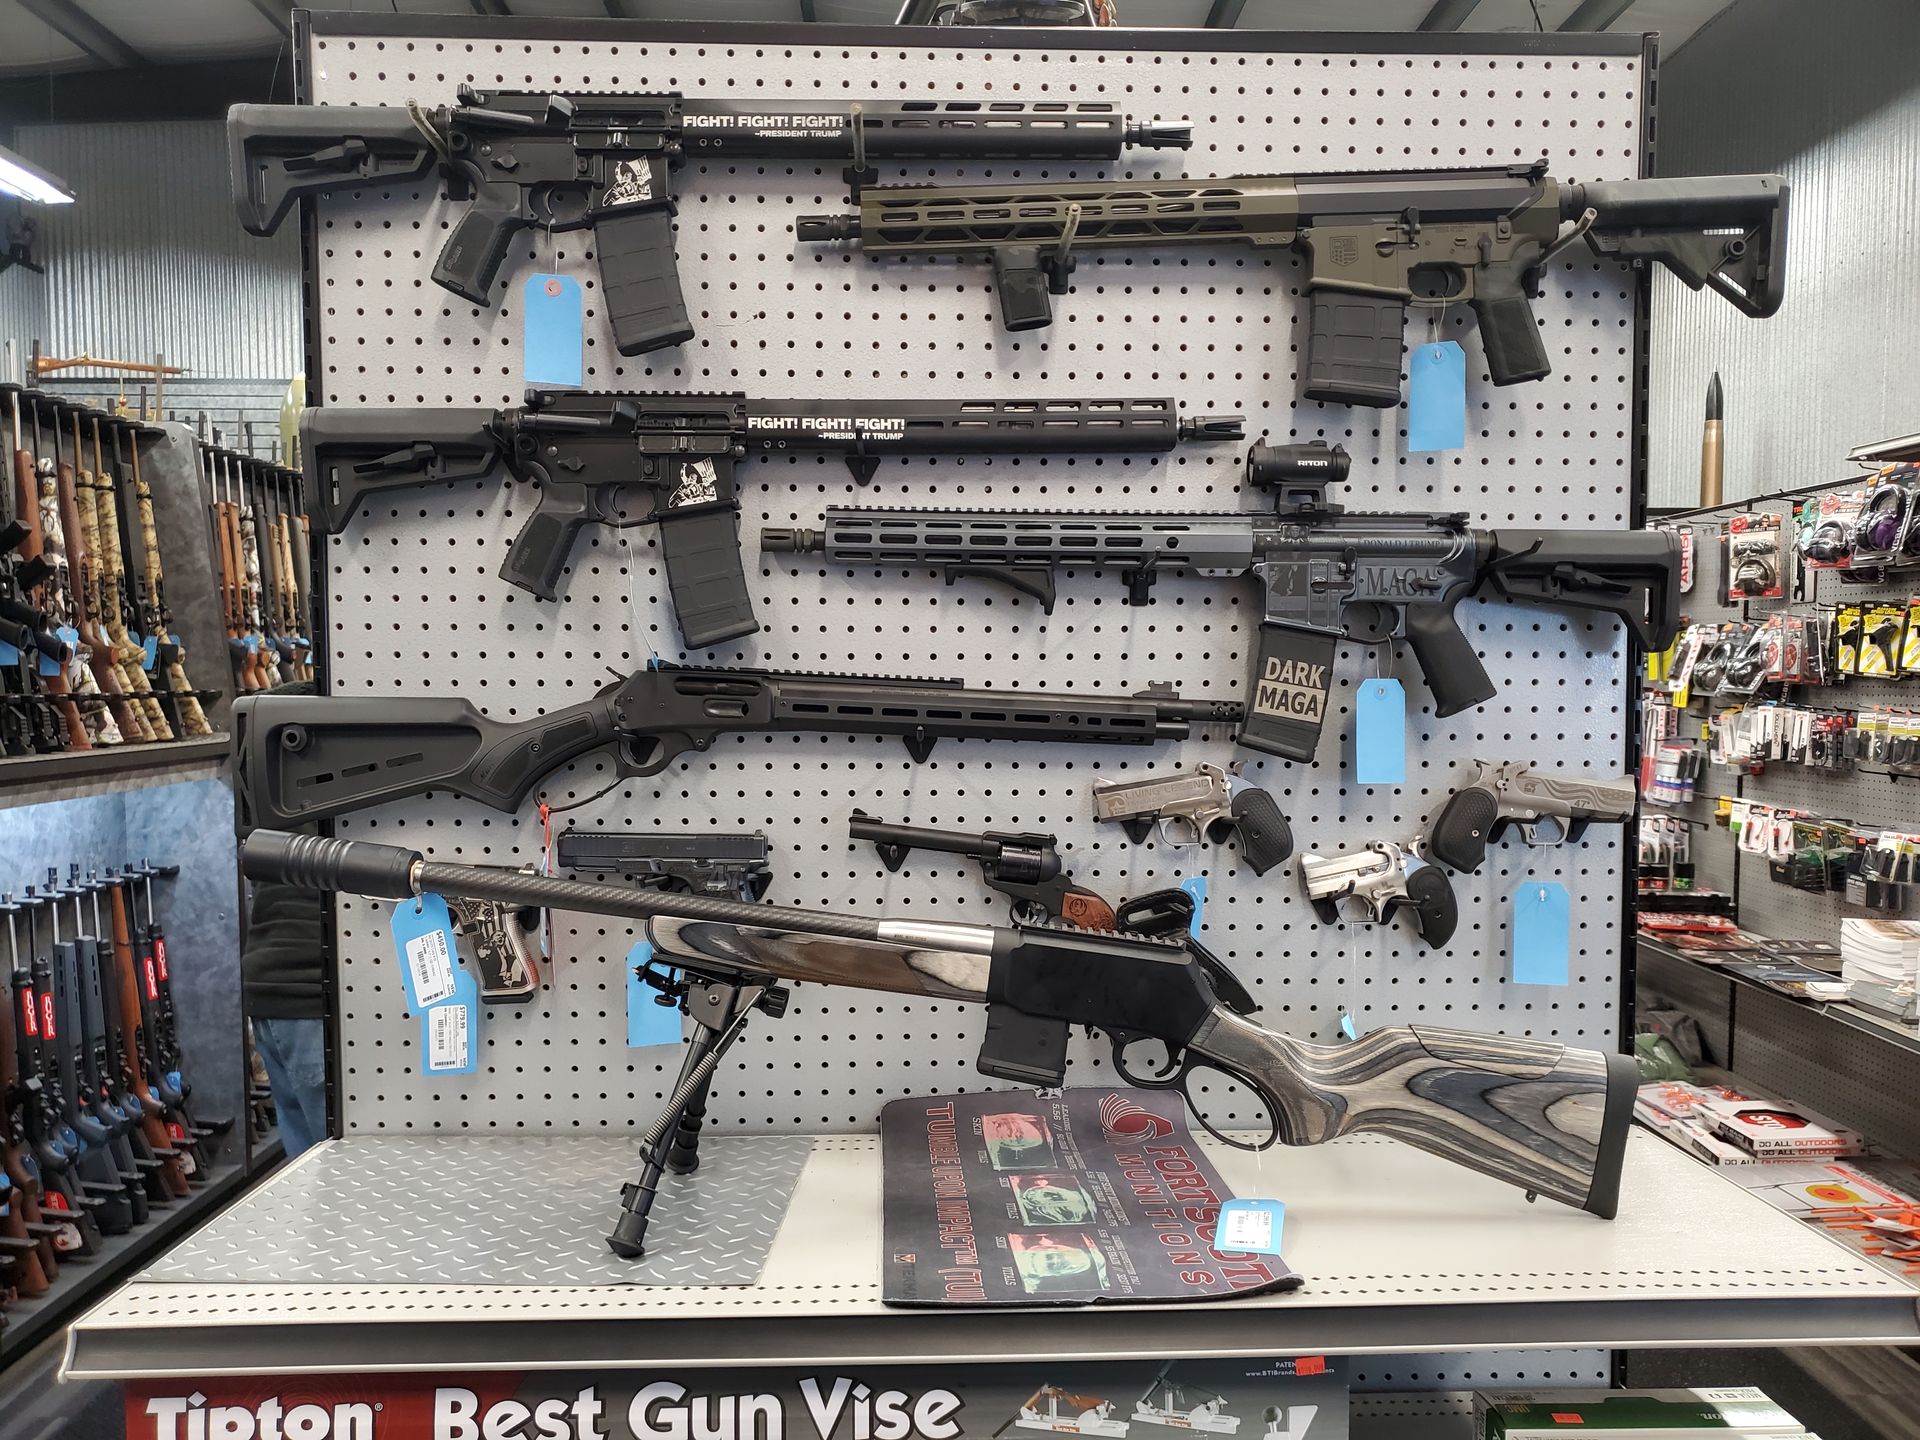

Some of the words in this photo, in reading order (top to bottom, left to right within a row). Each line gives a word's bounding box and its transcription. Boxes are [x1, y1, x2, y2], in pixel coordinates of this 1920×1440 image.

[683, 115, 734, 128] FIGHT!
[738, 115, 788, 128] FIGHT!
[792, 115, 843, 128] FIGHT!
[810, 130, 842, 138] TRUMP
[747, 417, 798, 430] FIGHT!
[801, 417, 852, 430] FIGHT!
[855, 418, 905, 430] FIGHT!
[872, 432, 904, 440] TRUMP
[1363, 539, 1402, 547] DONALD
[1409, 539, 1441, 547] TRUMP
[1264, 656, 1326, 688] DARK
[1258, 685, 1318, 717] MAGA
[436, 931, 447, 956] $450.00
[1052, 1103, 1061, 1120] 5.56
[1061, 1103, 1071, 1131] LEADING
[926, 1102, 961, 1165] TUMBLE
[972, 1117, 982, 1136] SKIN
[932, 1167, 967, 1197] UPON
[1143, 1146, 1222, 1205] FORT
[1114, 1154, 1216, 1286] MUNITIONS
[1001, 1266, 1016, 1286] VITALS
[433, 1387, 604, 1440] Best
[628, 1382, 783, 1440] Gun
[796, 1377, 961, 1440] Vise
